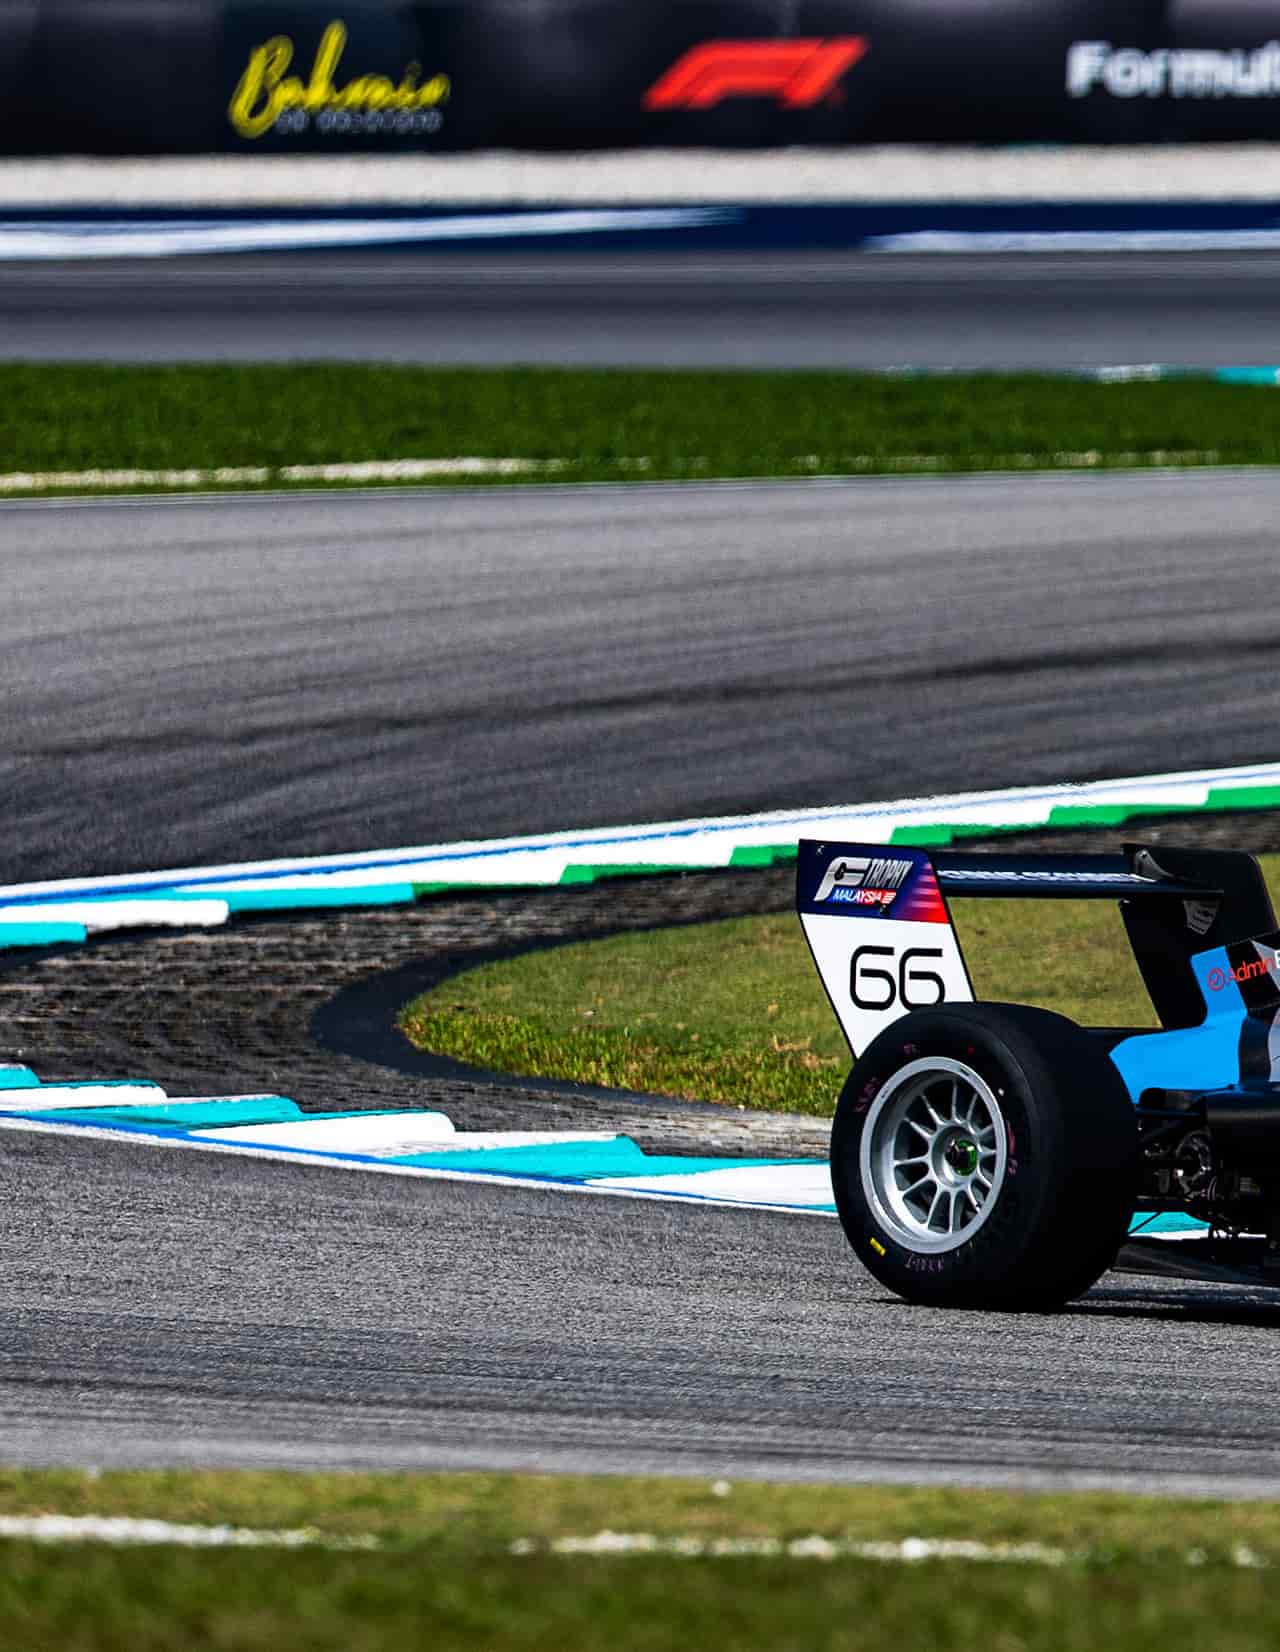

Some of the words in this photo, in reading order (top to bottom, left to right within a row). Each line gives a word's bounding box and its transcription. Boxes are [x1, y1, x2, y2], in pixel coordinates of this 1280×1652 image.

[864, 859, 914, 889] TROPHY
[832, 888, 884, 904] MALAYSIA
[850, 945, 946, 1011] 66
[1226, 957, 1276, 984] Admin
